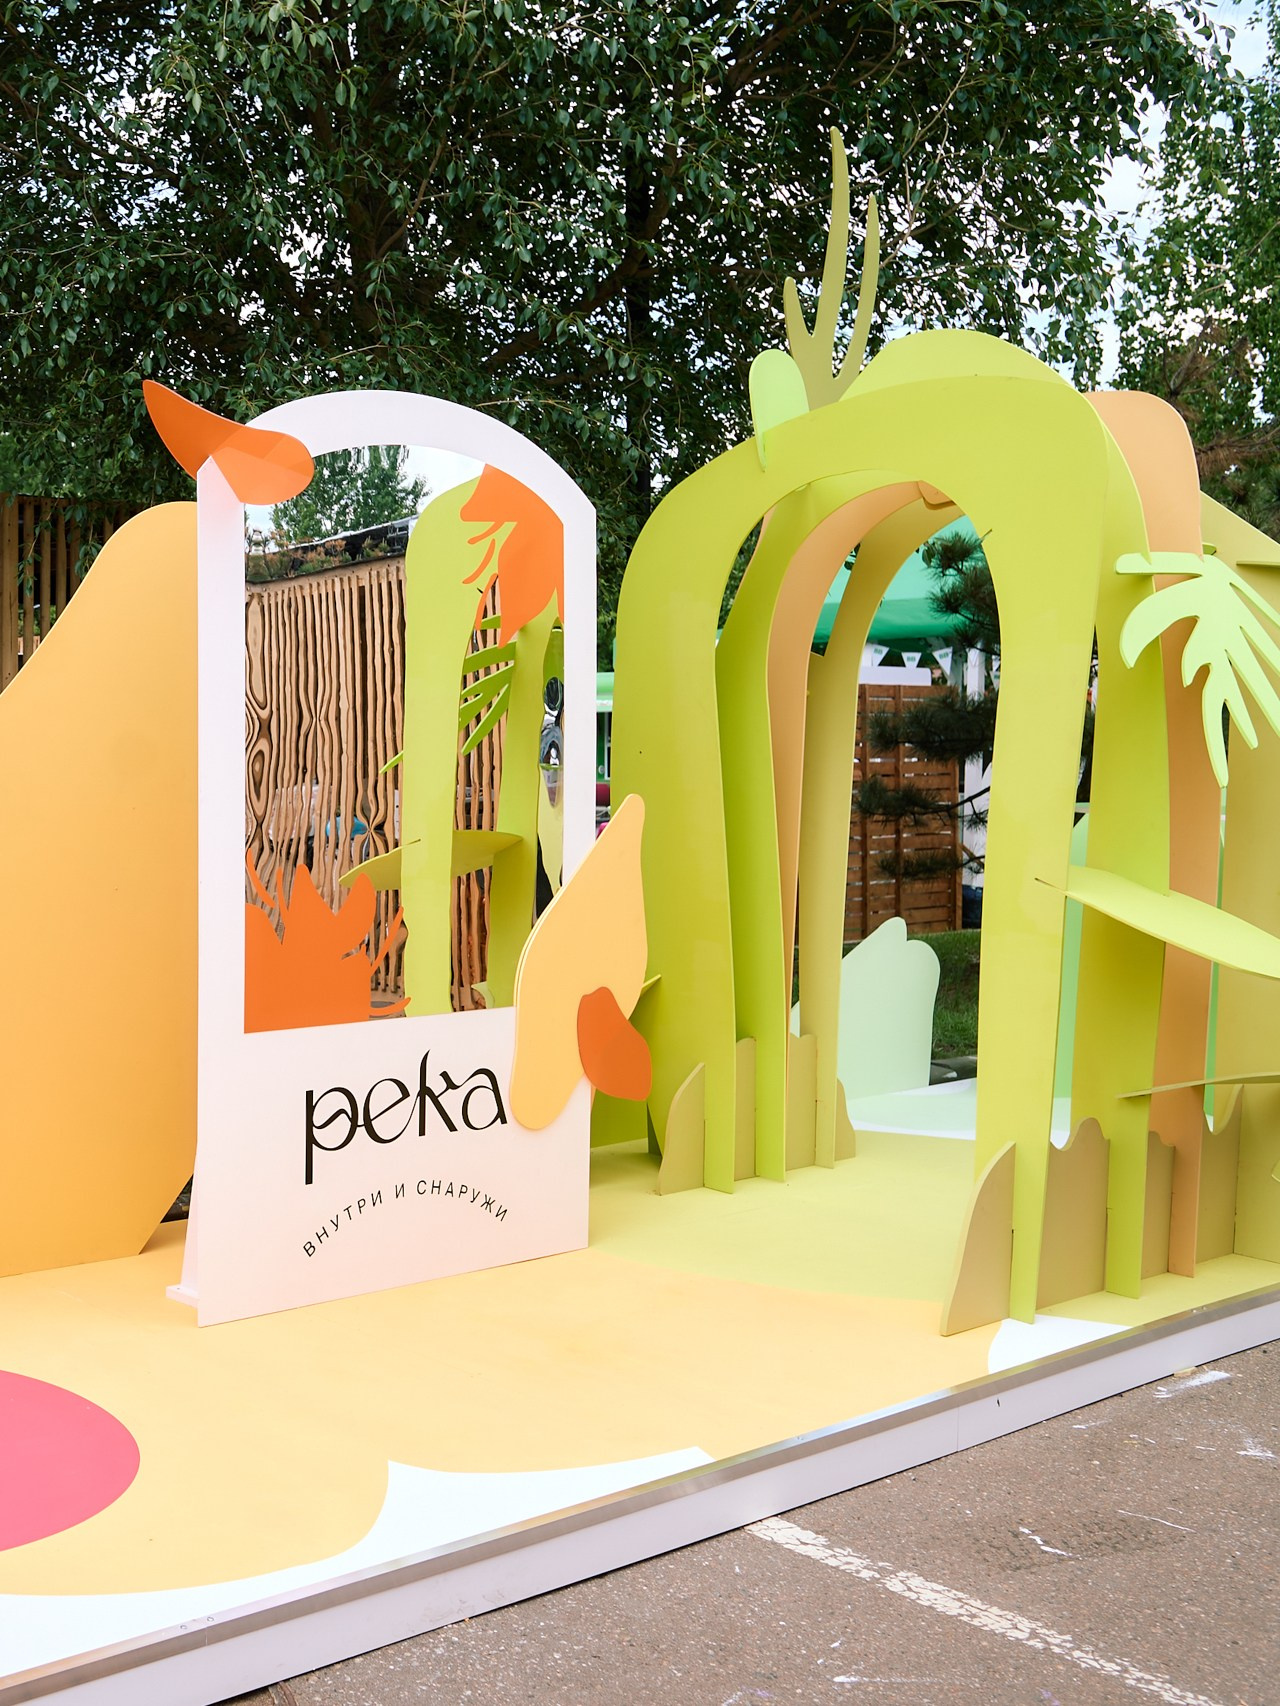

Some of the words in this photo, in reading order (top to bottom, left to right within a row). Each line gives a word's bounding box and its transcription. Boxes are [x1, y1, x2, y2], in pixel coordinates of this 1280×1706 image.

[304, 1049, 508, 1185] река
[302, 1189, 384, 1258] ВНУТРИ
[394, 1183, 406, 1199] И
[416, 1179, 509, 1222] СНАРУЖИ
